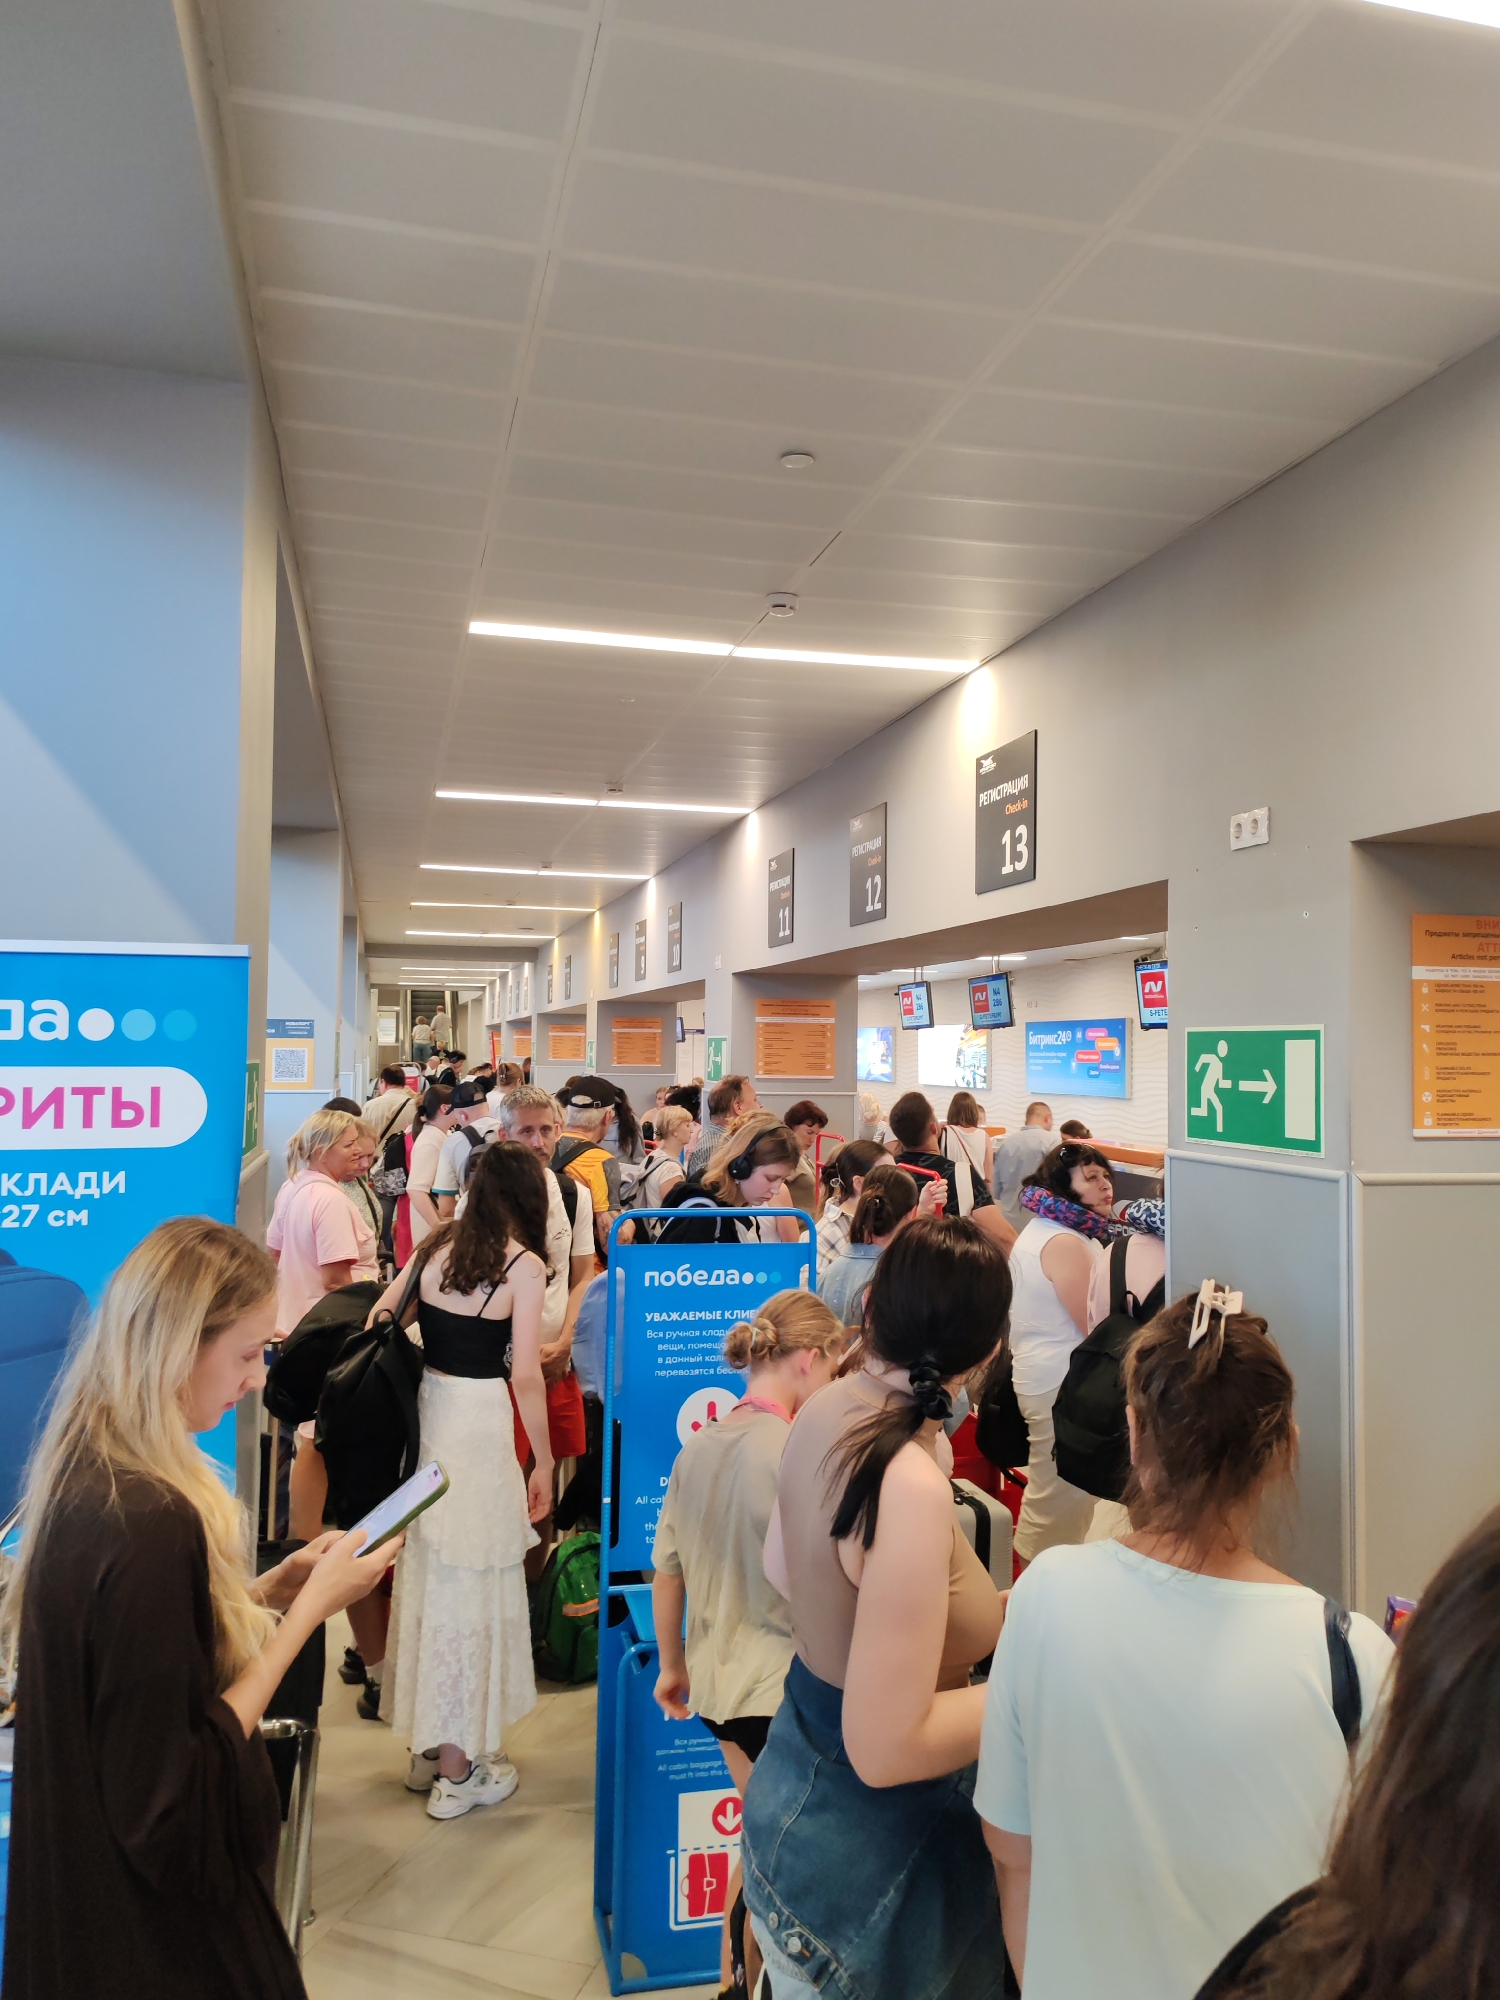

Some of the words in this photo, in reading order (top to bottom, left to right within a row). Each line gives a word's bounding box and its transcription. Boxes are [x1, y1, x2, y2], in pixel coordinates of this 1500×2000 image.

[980, 774, 1029, 807] РЕГИСТРАЦИЯ
[1005, 798, 1028, 815] Check-in
[852, 836, 882, 858] РЕГИСТРАЦИЯ
[1001, 824, 1029, 875] 13
[866, 875, 881, 912] 12
[779, 907, 790, 937] 11
[1425, 930, 1459, 938] Предметы
[673, 944, 680, 966] 10
[992, 987, 1001, 996] N4
[993, 999, 1002, 1007] 286
[1, 1171, 126, 1200] КЛАДИ
[0, 1204, 40, 1228] 27
[47, 1209, 89, 1227] см
[1108, 1223, 1143, 1237] SPOR
[644, 1263, 740, 1287] победа
[645, 1310, 722, 1322] УВАЖАЕМЫЕ
[725, 1309, 758, 1320] КЛИЕ
[647, 1330, 663, 1339] Вся
[666, 1330, 700, 1339] ручная
[658, 1342, 685, 1351] вещи,
[666, 1354, 703, 1364] данный
[655, 1369, 714, 1378] перевозятся
[636, 1496, 648, 1504] All
[689, 1737, 715, 1746] ручная
[668, 1763, 688, 1771] cabin
[690, 1760, 722, 1769] baggage
